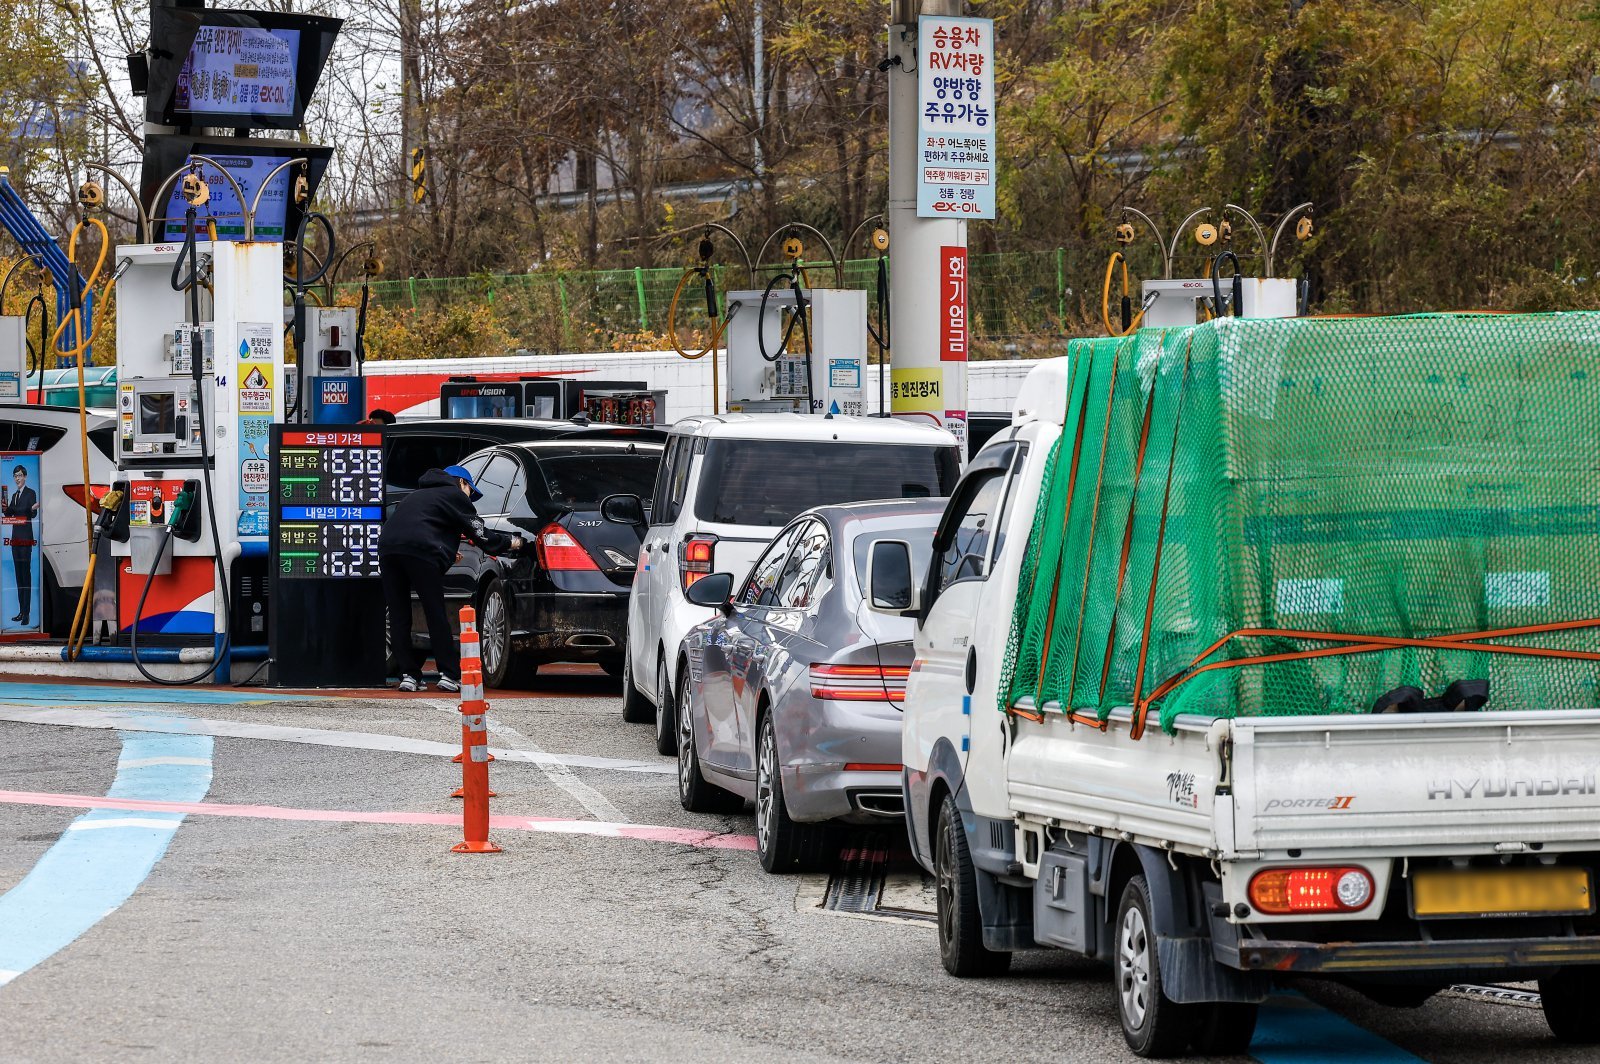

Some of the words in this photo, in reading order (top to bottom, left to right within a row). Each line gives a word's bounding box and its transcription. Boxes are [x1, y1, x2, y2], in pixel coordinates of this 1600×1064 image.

[932, 26, 980, 49] 승용차
[929, 51, 984, 75] RV차량
[933, 76, 981, 101] 양방향
[925, 102, 989, 127] 주유가능
[947, 138, 987, 151] 어느쪽이든
[924, 150, 948, 162] 편하게
[950, 151, 989, 163] 주유하세요
[925, 170, 946, 181] 역주행
[974, 171, 987, 182] 금지
[948, 256, 965, 352] 화기엄금
[250, 337, 272, 347] 품질인증
[253, 346, 269, 355] 주유소
[215, 376, 226, 387] 14
[323, 381, 347, 393] LIQUI
[901, 380, 940, 398] 엔진정지
[241, 391, 271, 401] 역주행금지
[323, 392, 347, 403] MOLY
[813, 400, 824, 409] 26
[243, 419, 269, 430] 탄소중립
[243, 429, 269, 439] 실천하기
[306, 433, 337, 445] 오늘의
[341, 433, 362, 445] 가격
[247, 462, 266, 473] 주유중
[281, 455, 318, 469] 휘발유
[323, 449, 382, 474] 1698
[331, 477, 383, 502] 1613
[305, 507, 337, 519] 내일의
[341, 507, 362, 519] 가격
[281, 531, 318, 544] 휘발유
[323, 524, 381, 549] 1708
[323, 551, 381, 576] 1623
[1427, 775, 1596, 800] HYUNDAI
[1263, 798, 1338, 812] PORTER
